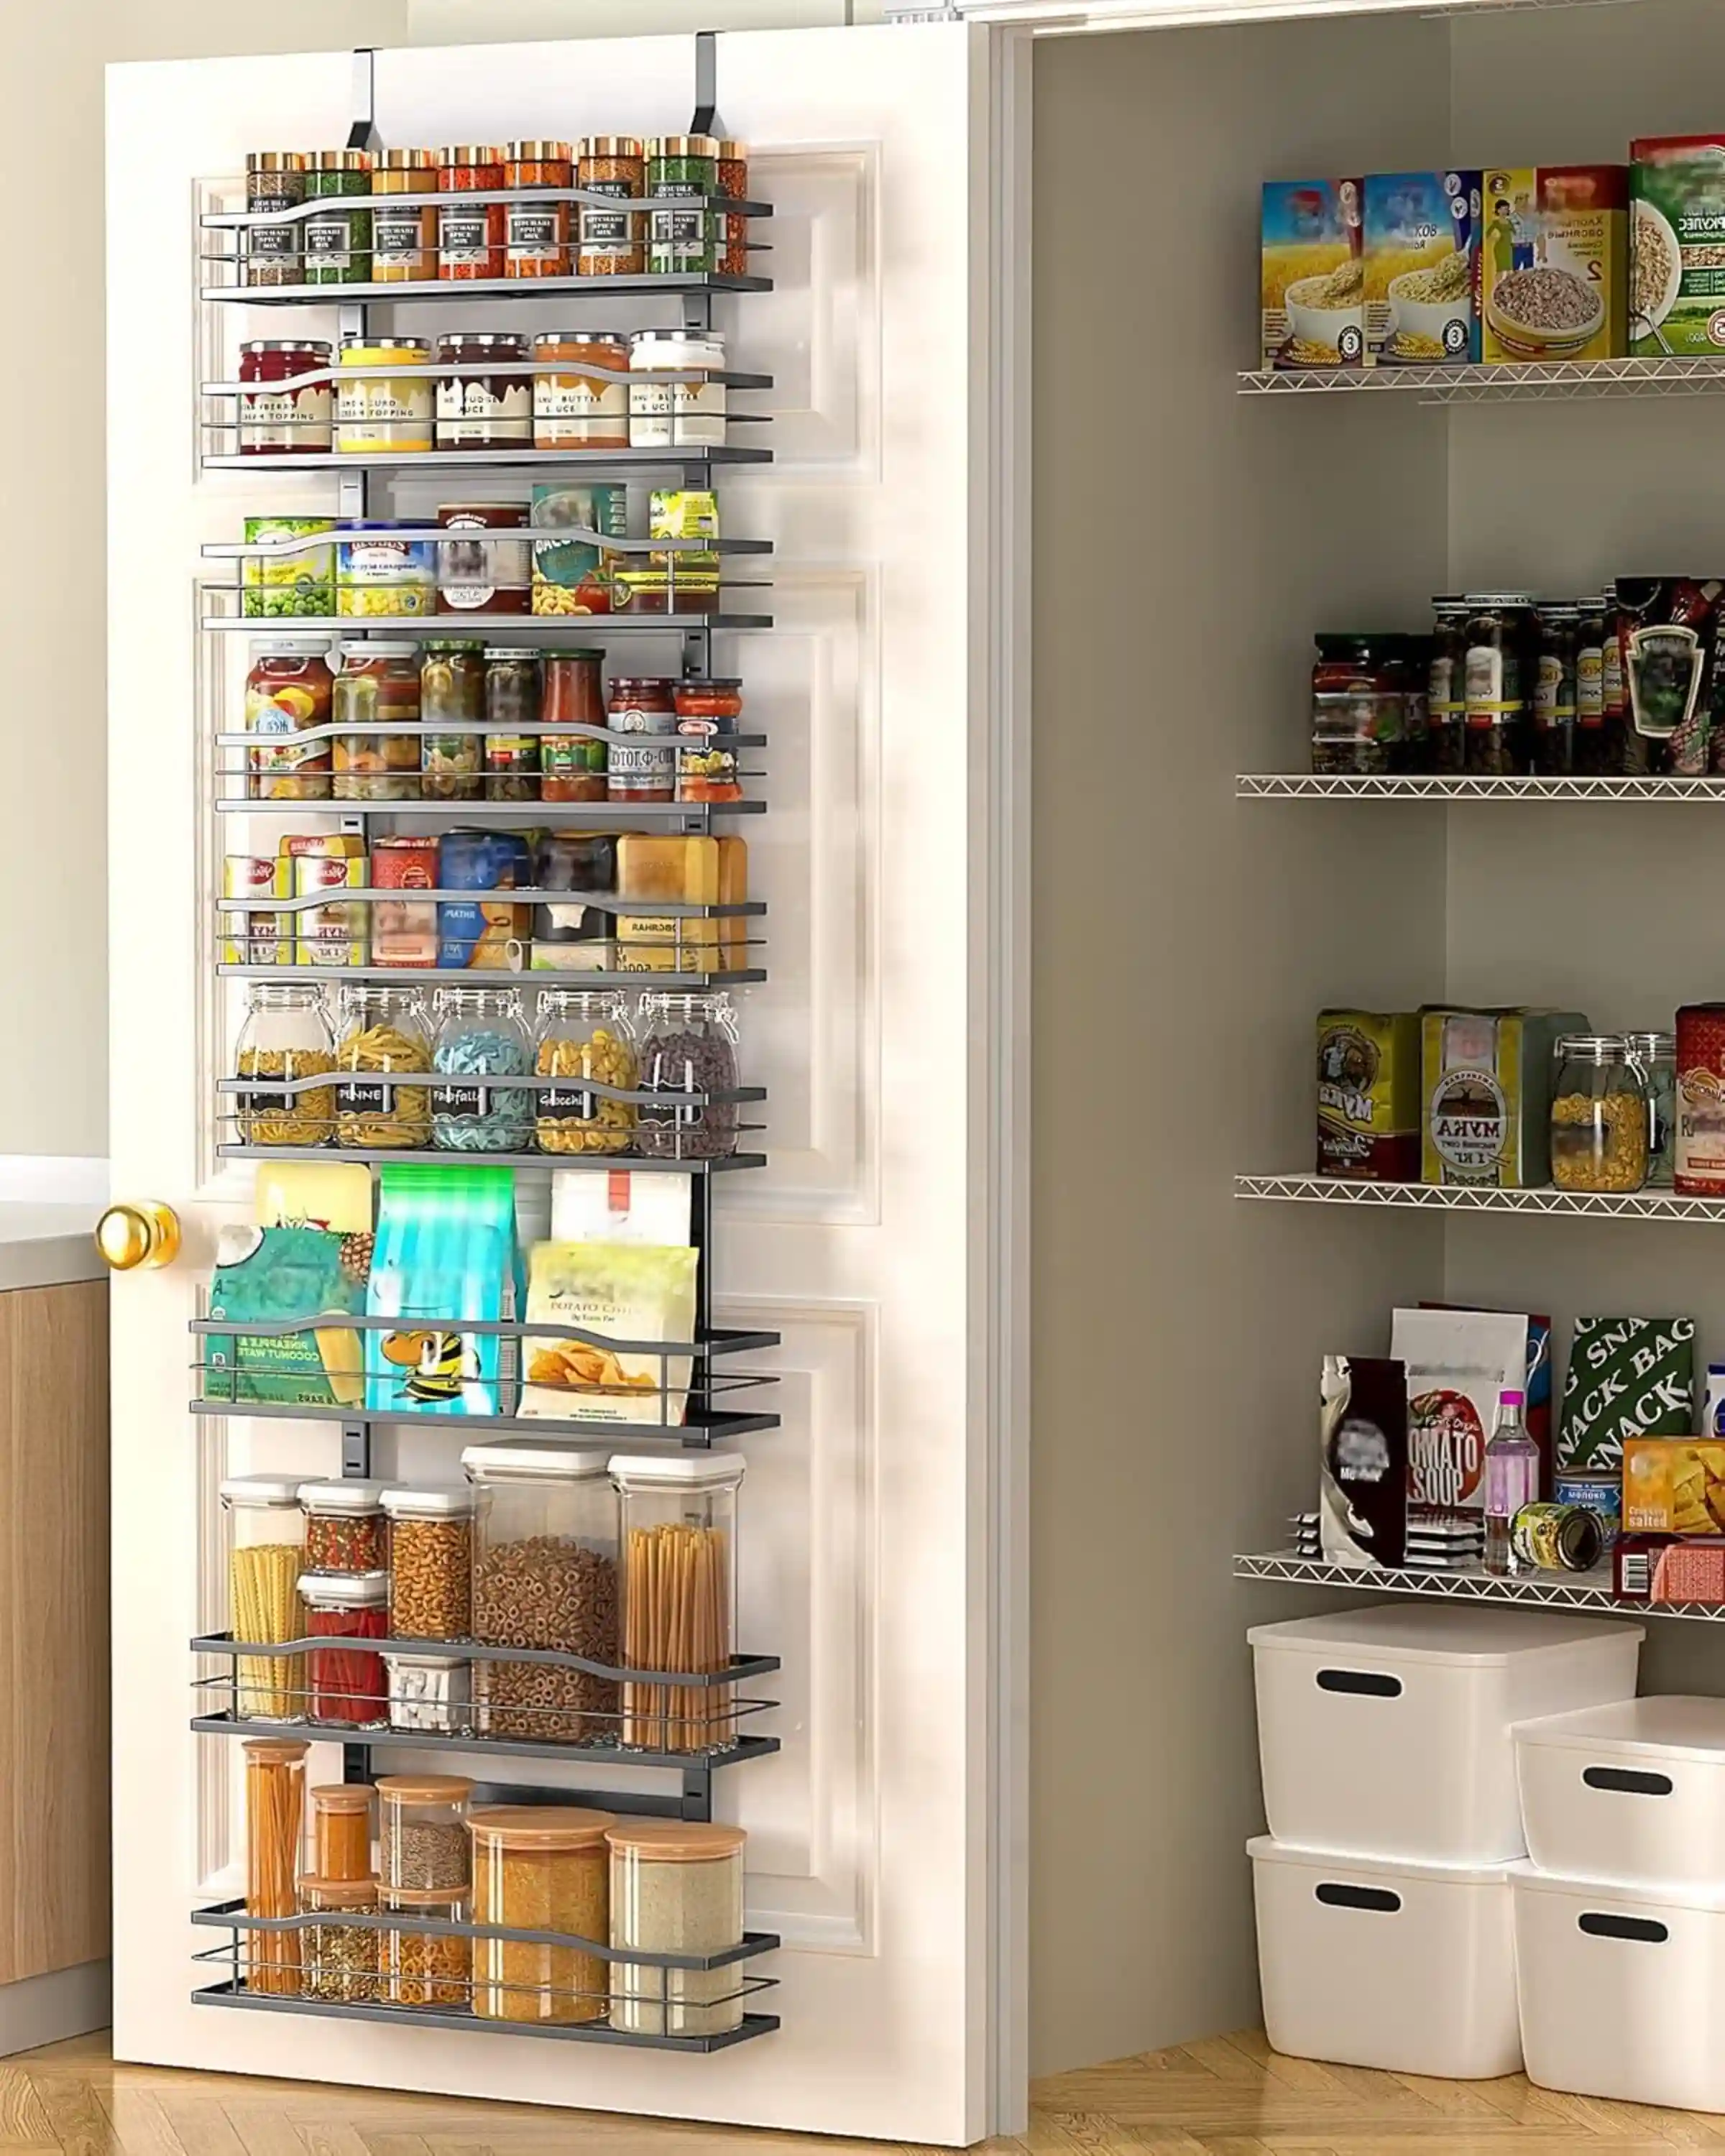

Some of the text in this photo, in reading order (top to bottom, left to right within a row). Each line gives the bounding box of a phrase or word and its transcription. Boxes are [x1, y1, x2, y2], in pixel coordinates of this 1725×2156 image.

[1347, 336, 1354, 350] 3
[1451, 329, 1458, 344] 3
[550, 1302, 599, 1312] POTATO
[1586, 1317, 1650, 1369] SNA
[1556, 1317, 1695, 1471] NACK BAG
[1408, 1427, 1478, 1473] OMATO
[1408, 1466, 1463, 1506] SOUP
